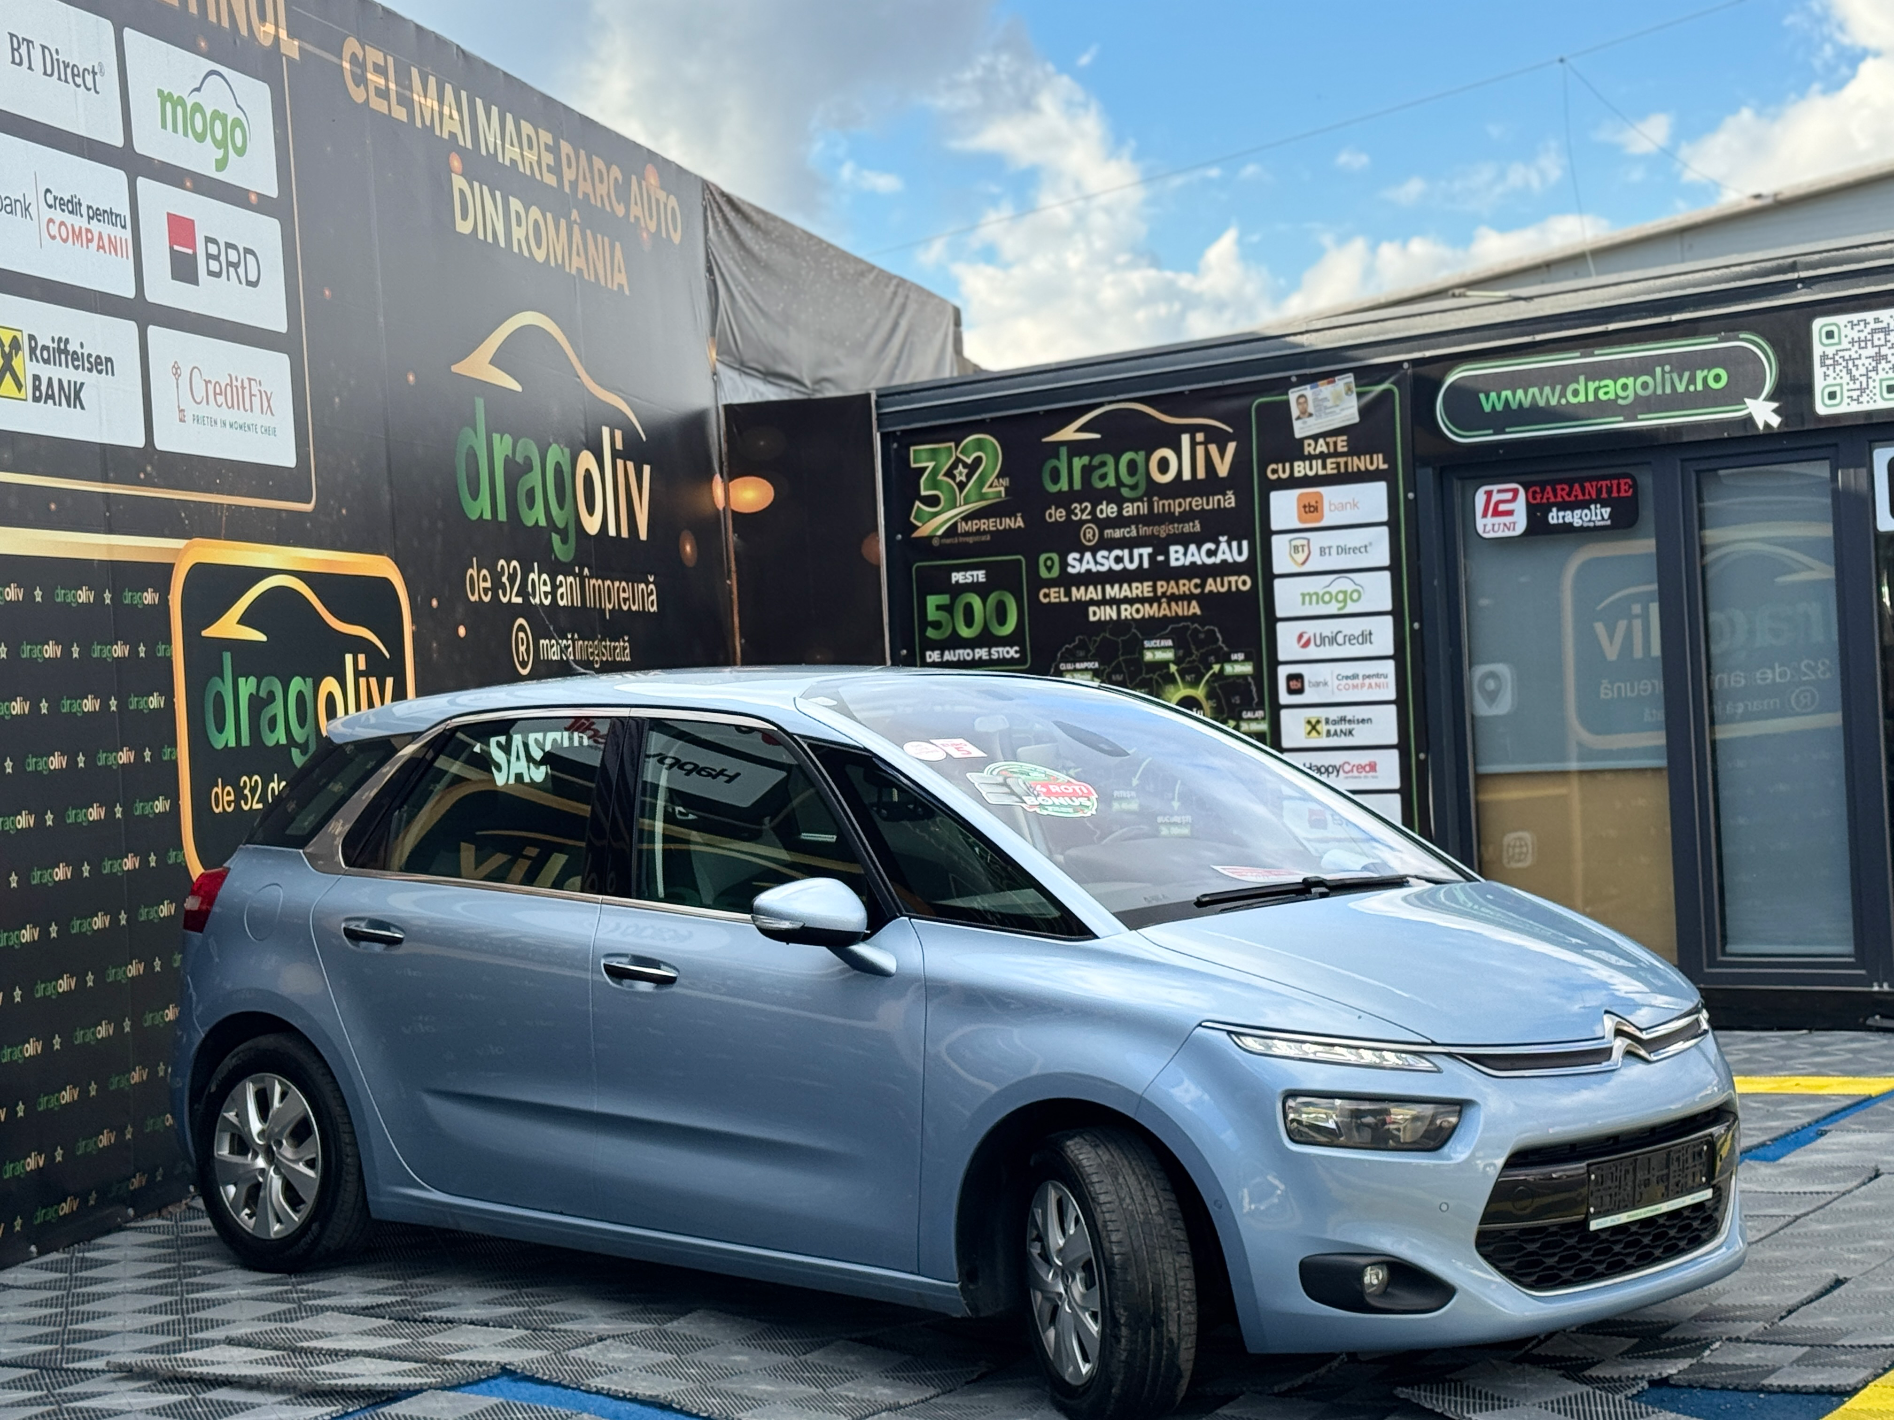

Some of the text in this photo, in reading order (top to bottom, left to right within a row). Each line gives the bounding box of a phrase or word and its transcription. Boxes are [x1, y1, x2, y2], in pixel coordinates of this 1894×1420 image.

[8, 32, 34, 71] BT
[157, 88, 248, 172] mogo
[342, 37, 682, 245] CEL MAI MARE PARC AUTO
[44, 188, 127, 230] Credit pentru
[46, 217, 129, 260] COMPANII
[451, 173, 630, 296] DIN ROMÂNIA
[204, 235, 261, 288] BRD
[28, 334, 115, 377] Raiffeisen
[32, 374, 86, 410] BANK
[189, 366, 275, 416] CreditFix
[1479, 365, 1729, 414] www.dragoliv.ro
[192, 413, 218, 427] PRIETEN
[220, 418, 227, 429] IN
[229, 421, 258, 434] MOMENTE
[260, 425, 277, 437] CHEIE
[1303, 436, 1348, 455] RATE
[456, 397, 651, 562] dragoliv
[910, 434, 1010, 526] 32 ANI
[1042, 432, 1237, 498] dragoliv
[1266, 453, 1389, 480] CU BULETINUL
[1045, 490, 1236, 522] de 32 de ani împreună
[1481, 487, 1520, 519] 12
[1527, 478, 1634, 504] GARANTIE
[1302, 499, 1360, 514] tbi bank
[1548, 503, 1611, 527] dragoliv
[957, 513, 1025, 533] ÎMPREUNĂ
[1104, 524, 1137, 539] marcă
[1138, 520, 1201, 538] înregistrată
[1482, 521, 1517, 534] LUNI
[1067, 547, 1153, 574] SASCUT
[1169, 536, 1249, 567] BACĂU
[1293, 543, 1306, 555] BT
[1319, 545, 1333, 557] BT
[466, 557, 658, 620] de 32 de ani împreună
[951, 570, 986, 584] PESTE
[1039, 575, 1251, 603] CEL MAI MARE PARC AUTO
[54, 585, 95, 607] dragoliv
[122, 588, 160, 608] dragoliv
[1088, 598, 1201, 621] DIN ROMÂNIA
[1300, 588, 1362, 611] mogo
[925, 590, 1018, 639] 500
[19, 640, 62, 663] dragoliv
[90, 640, 130, 662] dragoliv
[539, 633, 574, 661] marcă
[574, 633, 632, 669] înregistrată
[1313, 629, 1374, 647] UniCredit
[925, 646, 1020, 662] DE AUTO PE STOC
[1308, 679, 1330, 689] bank
[1336, 672, 1388, 681] Credit pentru
[1336, 681, 1389, 691] COMPANII
[60, 694, 100, 716] dragoliv
[128, 692, 165, 714] dragoliv
[1325, 715, 1373, 726] Raiffeisen
[1325, 728, 1355, 738] BANK
[25, 751, 68, 775] dragoliv
[96, 747, 135, 769] dragoliv
[211, 778, 235, 813] de
[240, 774, 263, 811] 32
[1023, 795, 1093, 807] BONUS
[65, 803, 106, 826] dragoliv
[133, 796, 170, 817] dragoliv
[30, 862, 72, 887] dragoliv
[102, 853, 140, 876] dragoliv
[70, 911, 111, 936] dragoliv
[138, 900, 176, 923] dragoliv
[34, 973, 76, 999] dragoliv
[105, 959, 145, 983] dragoliv
[1, 1037, 42, 1063] dragoliv
[73, 1019, 114, 1045] dragoliv
[37, 1065, 148, 1111] dragoliv dragoliv
[3, 1151, 45, 1179] dragoliv
[75, 1128, 116, 1156] dragoliv
[33, 1195, 79, 1224] dragoliv
